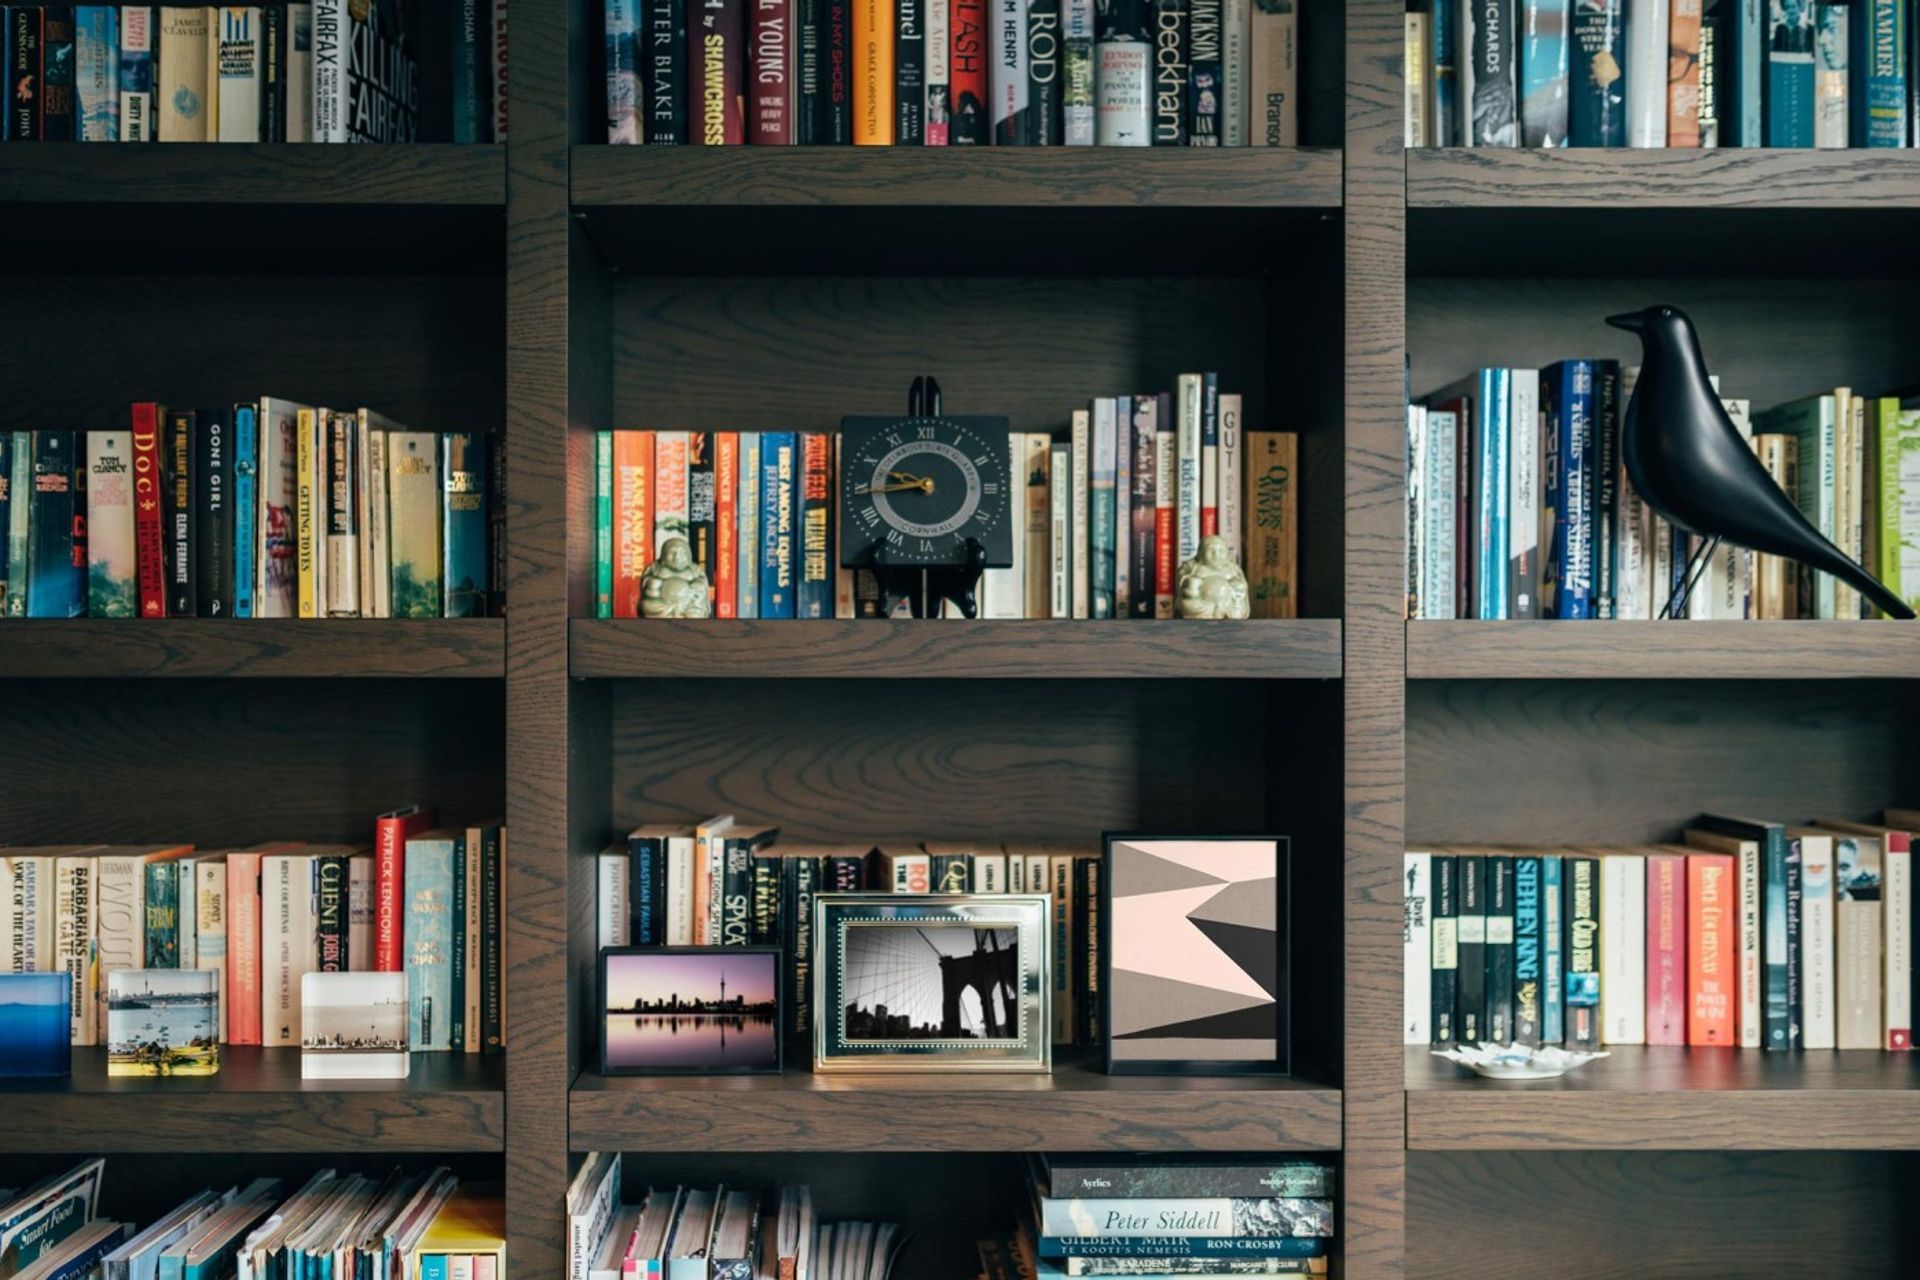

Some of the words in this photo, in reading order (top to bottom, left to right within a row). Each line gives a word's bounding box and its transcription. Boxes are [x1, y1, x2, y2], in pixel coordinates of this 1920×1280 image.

[756, 17, 784, 84] YOUNG
[832, 24, 843, 47] MY
[932, 26, 946, 60] After
[1004, 20, 1016, 69] HENRY
[1029, 12, 1057, 84] ROD
[867, 42, 877, 73] GRACE
[1072, 57, 1088, 92] Alan
[653, 55, 673, 121] BLAKE
[704, 34, 724, 145] SHAWCROSS
[832, 48, 844, 103] SHOES
[1158, 11, 1187, 141] beckham
[130, 96, 141, 120] DIRTY
[867, 75, 877, 137] CODDINGTON
[1040, 87, 1049, 99] The
[20, 108, 31, 138] JOHN
[1204, 384, 1216, 414] Raising
[885, 433, 903, 448] XI
[917, 427, 935, 440] XII
[953, 435, 963, 446] I
[1204, 415, 1215, 435] boys
[209, 424, 222, 468] GONE
[804, 434, 827, 471] PRIMAL
[974, 455, 989, 467] II
[1075, 428, 1086, 460] YEAR
[1430, 419, 1439, 501] THOMAS
[1439, 424, 1452, 493] LEXUS
[93, 465, 127, 475] CLANCY
[100, 457, 120, 466] TOM
[134, 432, 155, 494] DOC
[778, 446, 791, 480] FIRST
[1075, 462, 1086, 471] IN
[1160, 438, 1173, 501] Manhood
[1181, 457, 1194, 488] kids
[1824, 452, 1834, 489] GOAL
[209, 474, 222, 511] GIRL
[619, 466, 633, 518] JEFFREY
[632, 466, 645, 507] KANE
[690, 472, 703, 522] ARCHER
[764, 465, 778, 513] JEFFREY
[804, 474, 827, 500] FEAR
[983, 483, 998, 495] III
[1075, 473, 1087, 528] PROVENCE
[1134, 472, 1153, 496] Key
[1180, 489, 1191, 506] are
[1884, 437, 1900, 531] RECEPTIONIST
[301, 485, 311, 533] GETTING
[778, 481, 791, 533] AMONG
[860, 506, 881, 529] VIII
[1096, 492, 1106, 516] Under
[1257, 475, 1271, 528] WIVES
[176, 512, 188, 540] ELENA
[632, 509, 645, 540] AND
[765, 514, 778, 568] ARCHER
[804, 507, 827, 550] WILLIAM
[885, 529, 904, 547] VII
[900, 522, 955, 535] CORNWALL
[1160, 511, 1169, 540] Steve
[1180, 508, 1194, 557] worth
[1439, 500, 1453, 565] OLIVE
[301, 535, 311, 549] TO
[619, 520, 632, 578] ARCHER
[919, 539, 934, 553] VI
[1429, 506, 1439, 609] FRIEDMAN
[176, 542, 188, 585] FERRANTE
[301, 551, 311, 572] YES
[632, 544, 645, 579] ABEL
[776, 535, 791, 588] EQUALS
[804, 551, 827, 582] DIEHL
[1160, 543, 1169, 592] Biddulph
[1440, 568, 1453, 618] TREE
[102, 862, 133, 874] HERMAN
[380, 826, 393, 878] PATRICK
[1745, 850, 1755, 873] STAY
[13, 861, 25, 892] VOICE
[25, 861, 36, 917] BARBARA
[60, 867, 74, 885] AT
[608, 864, 620, 892] JOHN
[640, 846, 651, 904] SEBASTIAN
[711, 865, 721, 908] WEDDING
[755, 866, 770, 883] LA
[798, 869, 811, 891] The
[1788, 868, 1797, 887] The
[1894, 862, 1902, 884] THE
[13, 894, 25, 907] OF
[60, 889, 74, 915] THE
[320, 862, 342, 926] CLIENT
[1515, 859, 1538, 936] STEPHEN
[1894, 891, 1902, 931] HUMAN
[13, 910, 25, 932] THE
[75, 866, 88, 958] BARBARIANS
[380, 881, 393, 943] LENCIONI
[610, 895, 621, 944] GRISHAM
[640, 905, 651, 944] FAULKS
[724, 894, 747, 946] SPYCA
[1414, 896, 1426, 928] David
[1746, 912, 1755, 926] MY
[1788, 889, 1800, 936] Reader
[25, 919, 36, 960] TAYLOR
[60, 921, 74, 958] GATE
[319, 933, 340, 962] JOHN
[1746, 930, 1755, 951] SON
[1515, 937, 1538, 980] KING
[1081, 1177, 1112, 1190] Ayrlies
[20, 1219, 49, 1251] Smart
[50, 1198, 75, 1230] Food
[1105, 1210, 1150, 1230] Peter
[1156, 1210, 1221, 1230] Siddell
[574, 1224, 582, 1258] annabel
[1061, 1246, 1076, 1254] TE
[1081, 1246, 1132, 1255] KOOTI'S
[1136, 1246, 1191, 1255] NEMESIS
[1206, 1239, 1233, 1250] RON
[1236, 1239, 1284, 1250] CROSBY
